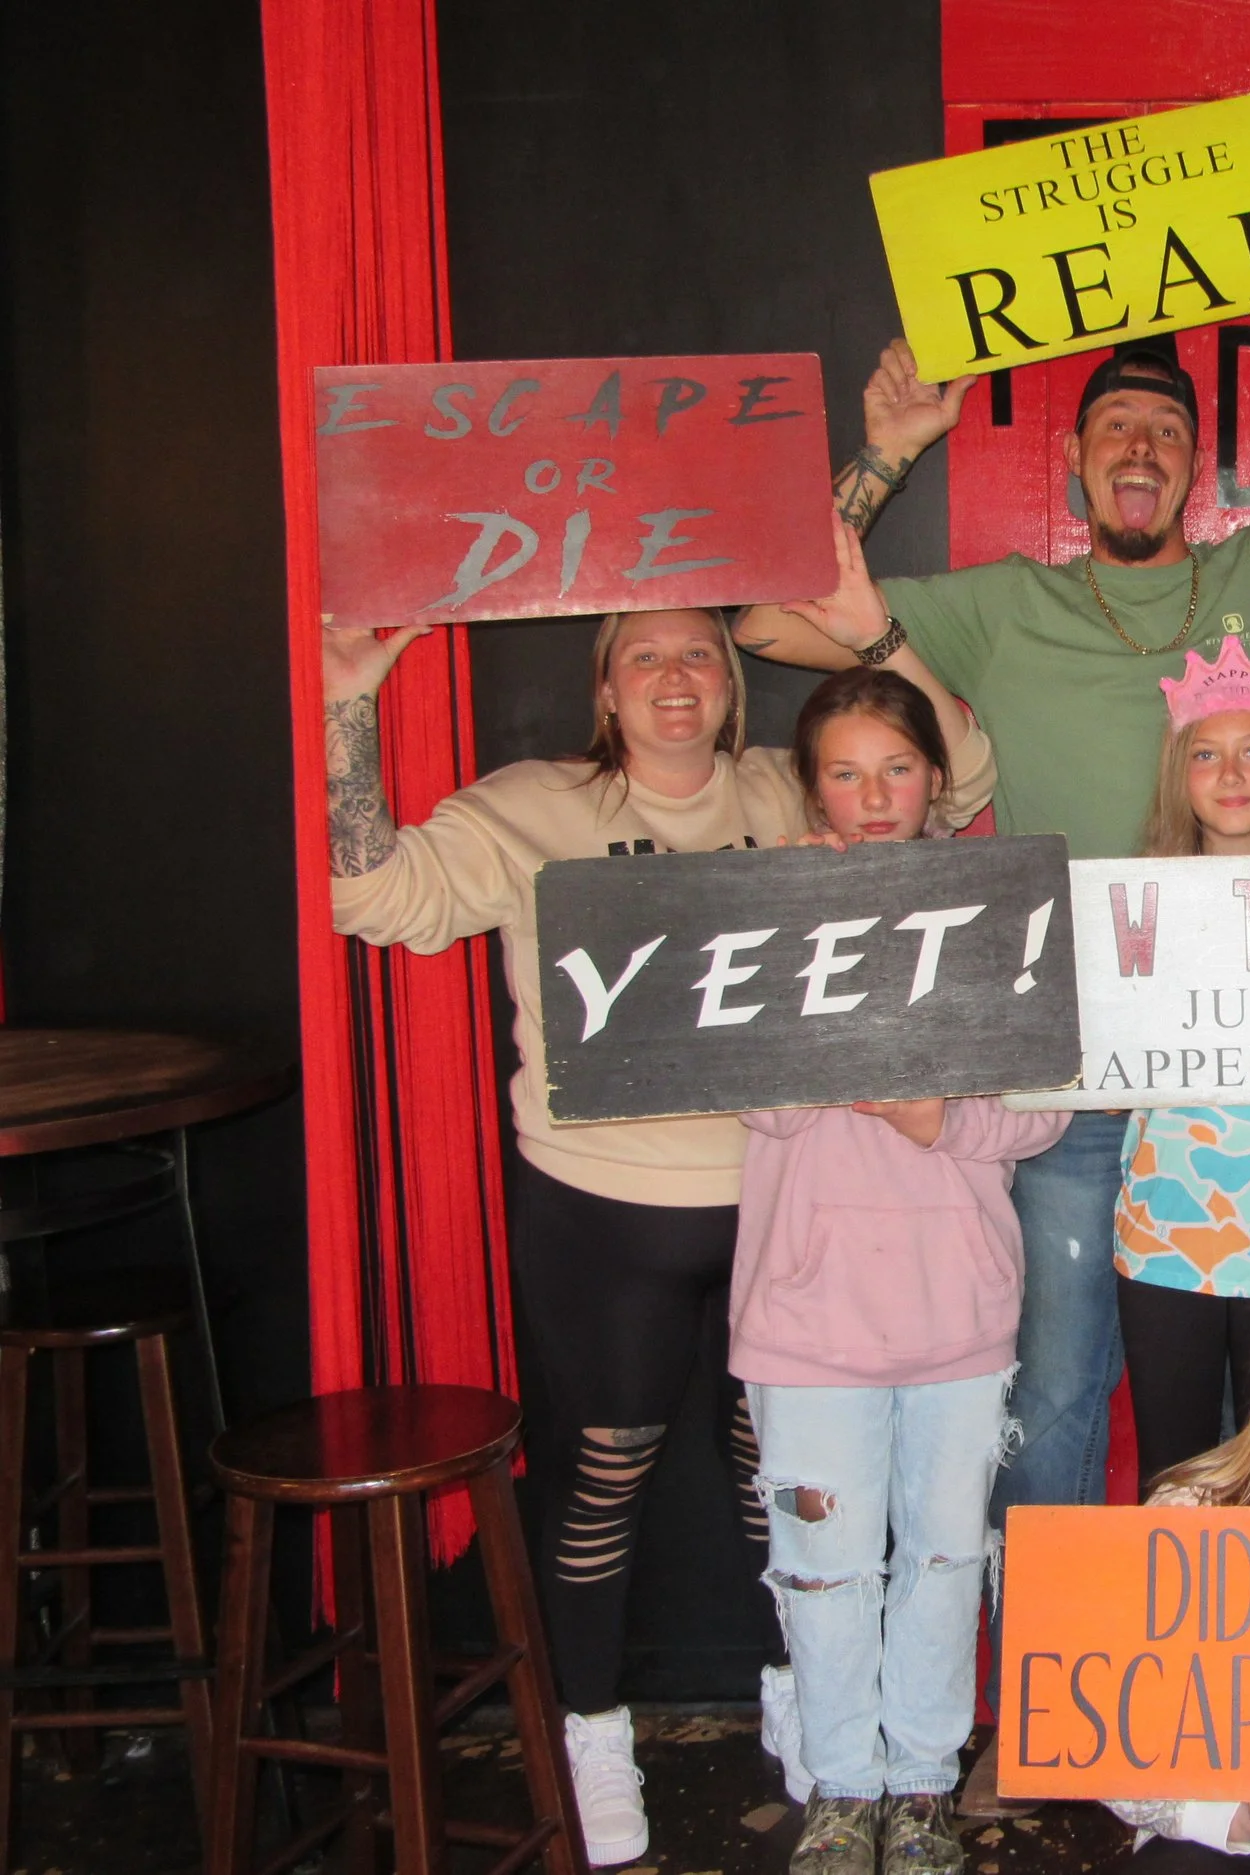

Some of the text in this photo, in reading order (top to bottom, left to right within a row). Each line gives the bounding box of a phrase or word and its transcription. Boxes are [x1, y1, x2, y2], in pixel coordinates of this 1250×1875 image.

[979, 142, 1235, 222] STRUGGLE
[1050, 125, 1146, 169] THE
[1097, 199, 1138, 233] IS
[317, 370, 805, 440] ESCAPE
[524, 458, 617, 494] OR
[410, 507, 735, 614] DIE
[555, 898, 1055, 1043] YEET!
